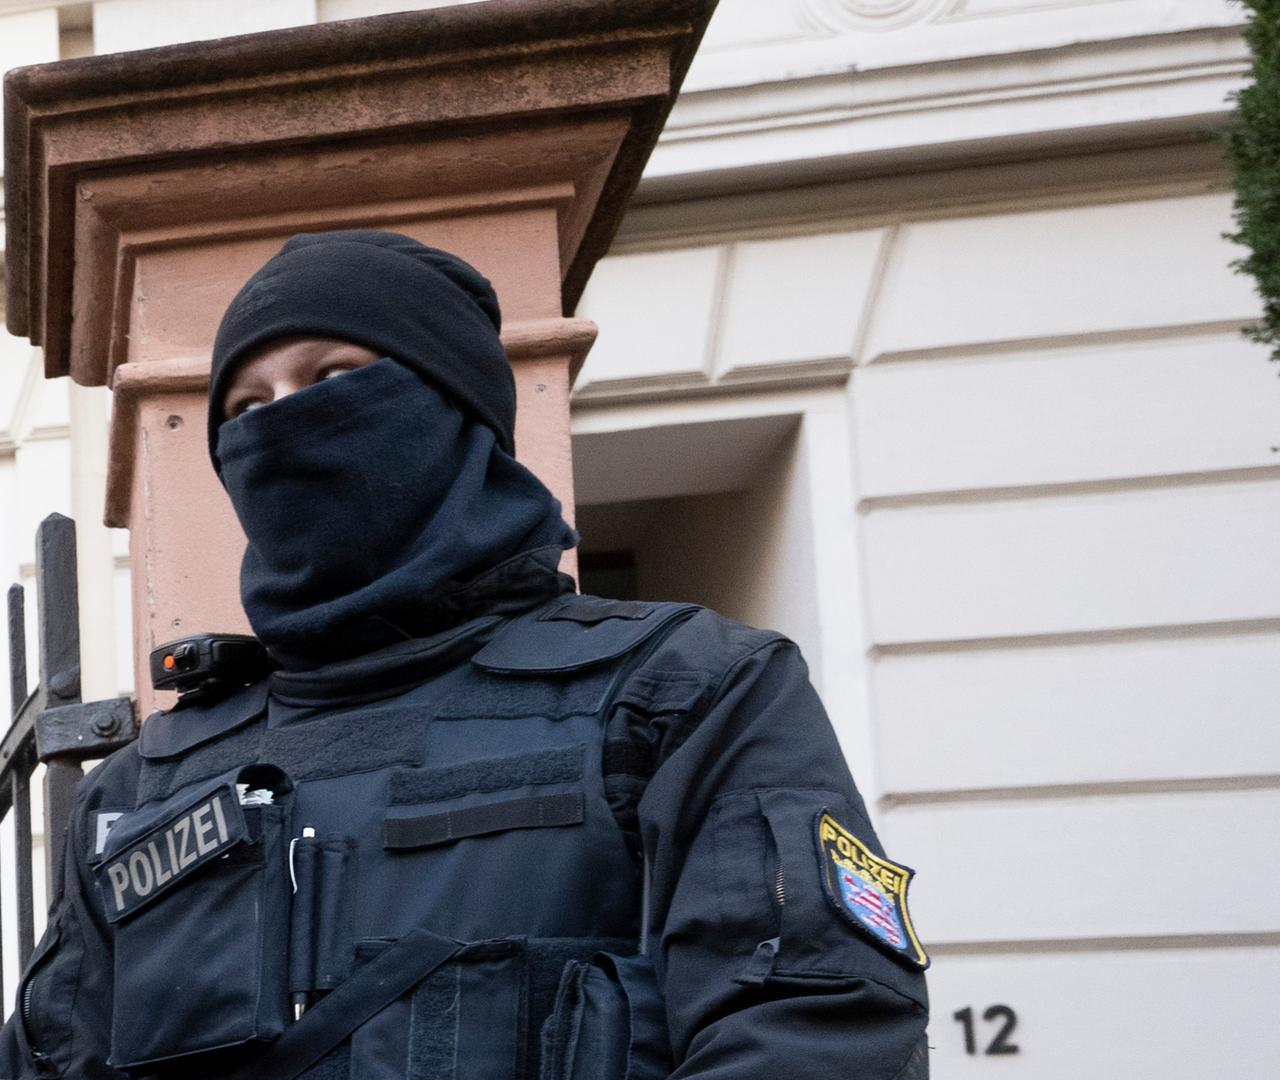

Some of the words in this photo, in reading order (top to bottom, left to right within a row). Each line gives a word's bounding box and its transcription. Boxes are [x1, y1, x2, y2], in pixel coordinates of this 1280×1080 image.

[107, 796, 229, 912] POLIZEI
[822, 822, 901, 895] POLIZEI
[953, 1004, 1020, 1057] 12
